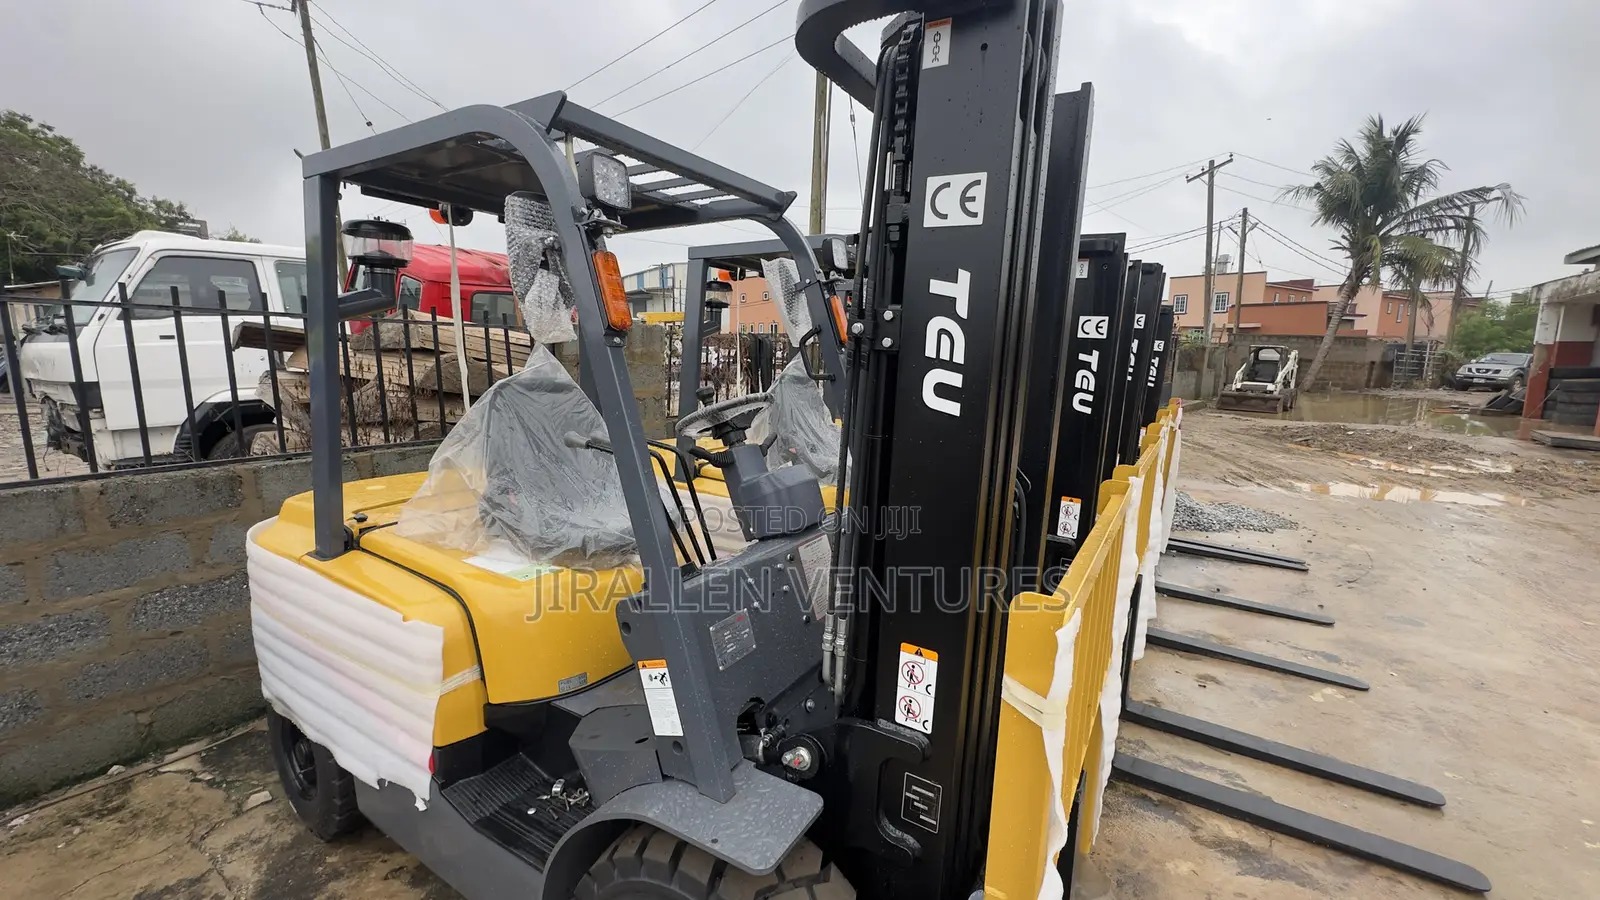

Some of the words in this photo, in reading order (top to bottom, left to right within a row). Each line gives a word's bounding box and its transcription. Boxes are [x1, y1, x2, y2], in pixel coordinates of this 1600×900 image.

[930, 180, 982, 219] CE
[922, 268, 971, 417] TEU
[1081, 319, 1105, 335] CE
[1072, 350, 1099, 415] TEU
